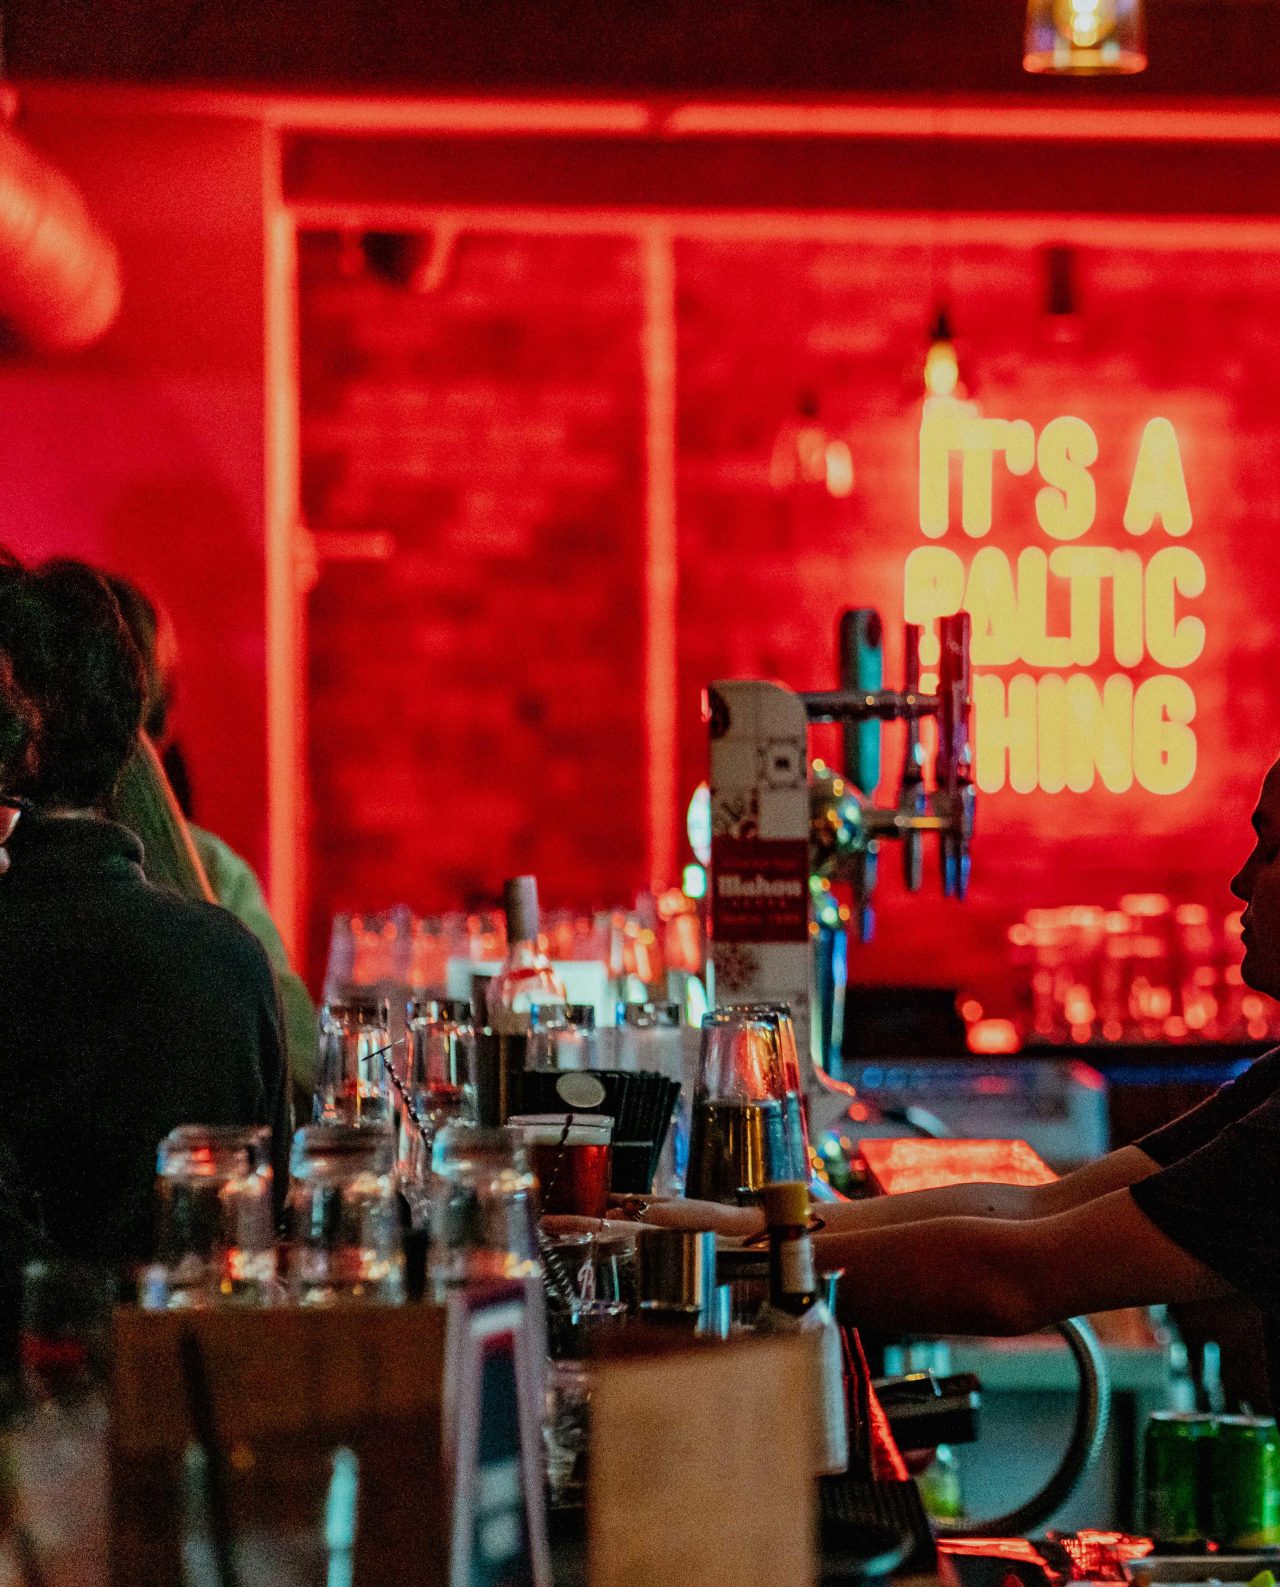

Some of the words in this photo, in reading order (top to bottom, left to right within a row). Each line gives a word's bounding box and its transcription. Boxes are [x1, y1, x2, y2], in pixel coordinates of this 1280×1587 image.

[919, 405, 1098, 540] IT'S
[1123, 417, 1193, 536] A
[918, 673, 1198, 795] HING
